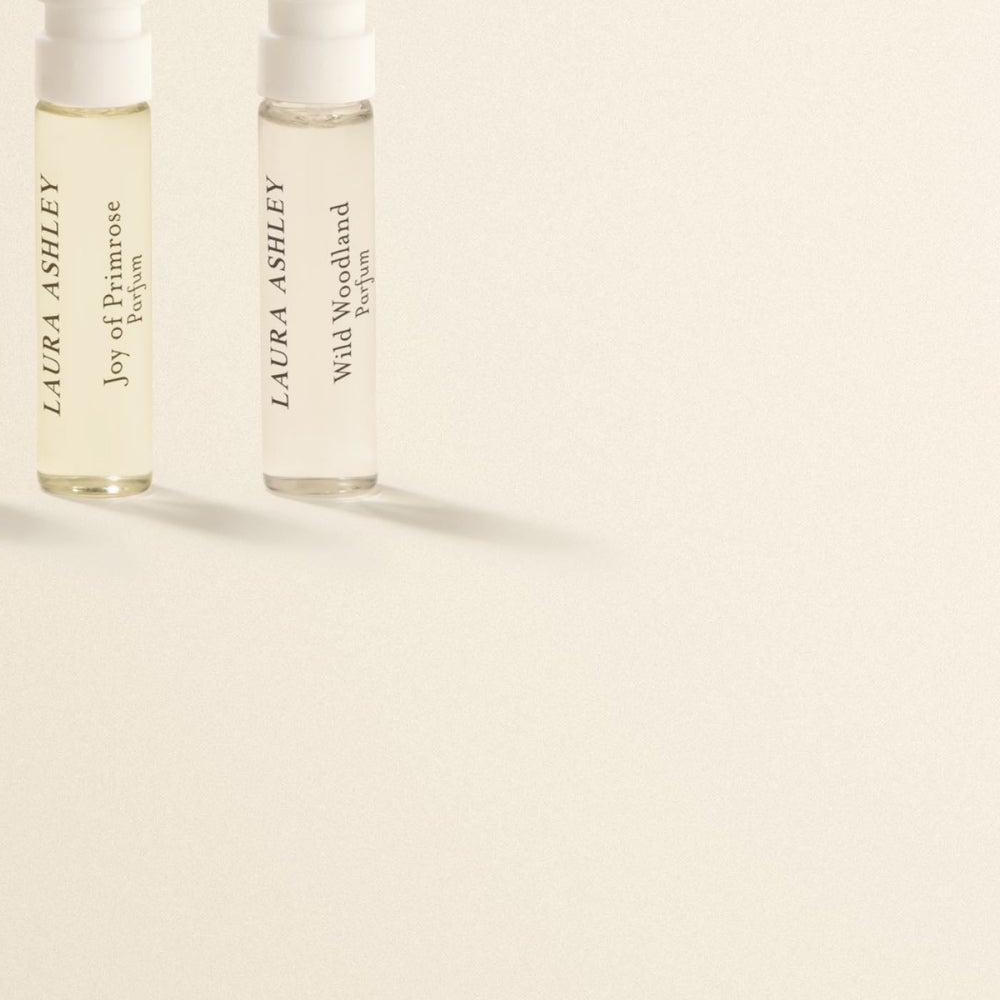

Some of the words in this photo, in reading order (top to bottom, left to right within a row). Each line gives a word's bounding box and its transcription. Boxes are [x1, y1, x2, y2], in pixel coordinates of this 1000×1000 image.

[39, 173, 60, 301] ASHLEY
[102, 200, 123, 309] Primrose
[265, 175, 287, 295] ASHLEY
[329, 201, 351, 324] Woodland
[354, 249, 375, 319] Parfum
[102, 315, 124, 340] of
[126, 254, 147, 325] Parfum
[41, 313, 62, 417] LAURA
[103, 349, 131, 387] Joy
[269, 306, 290, 409] LAURA
[331, 327, 353, 384] Wild
